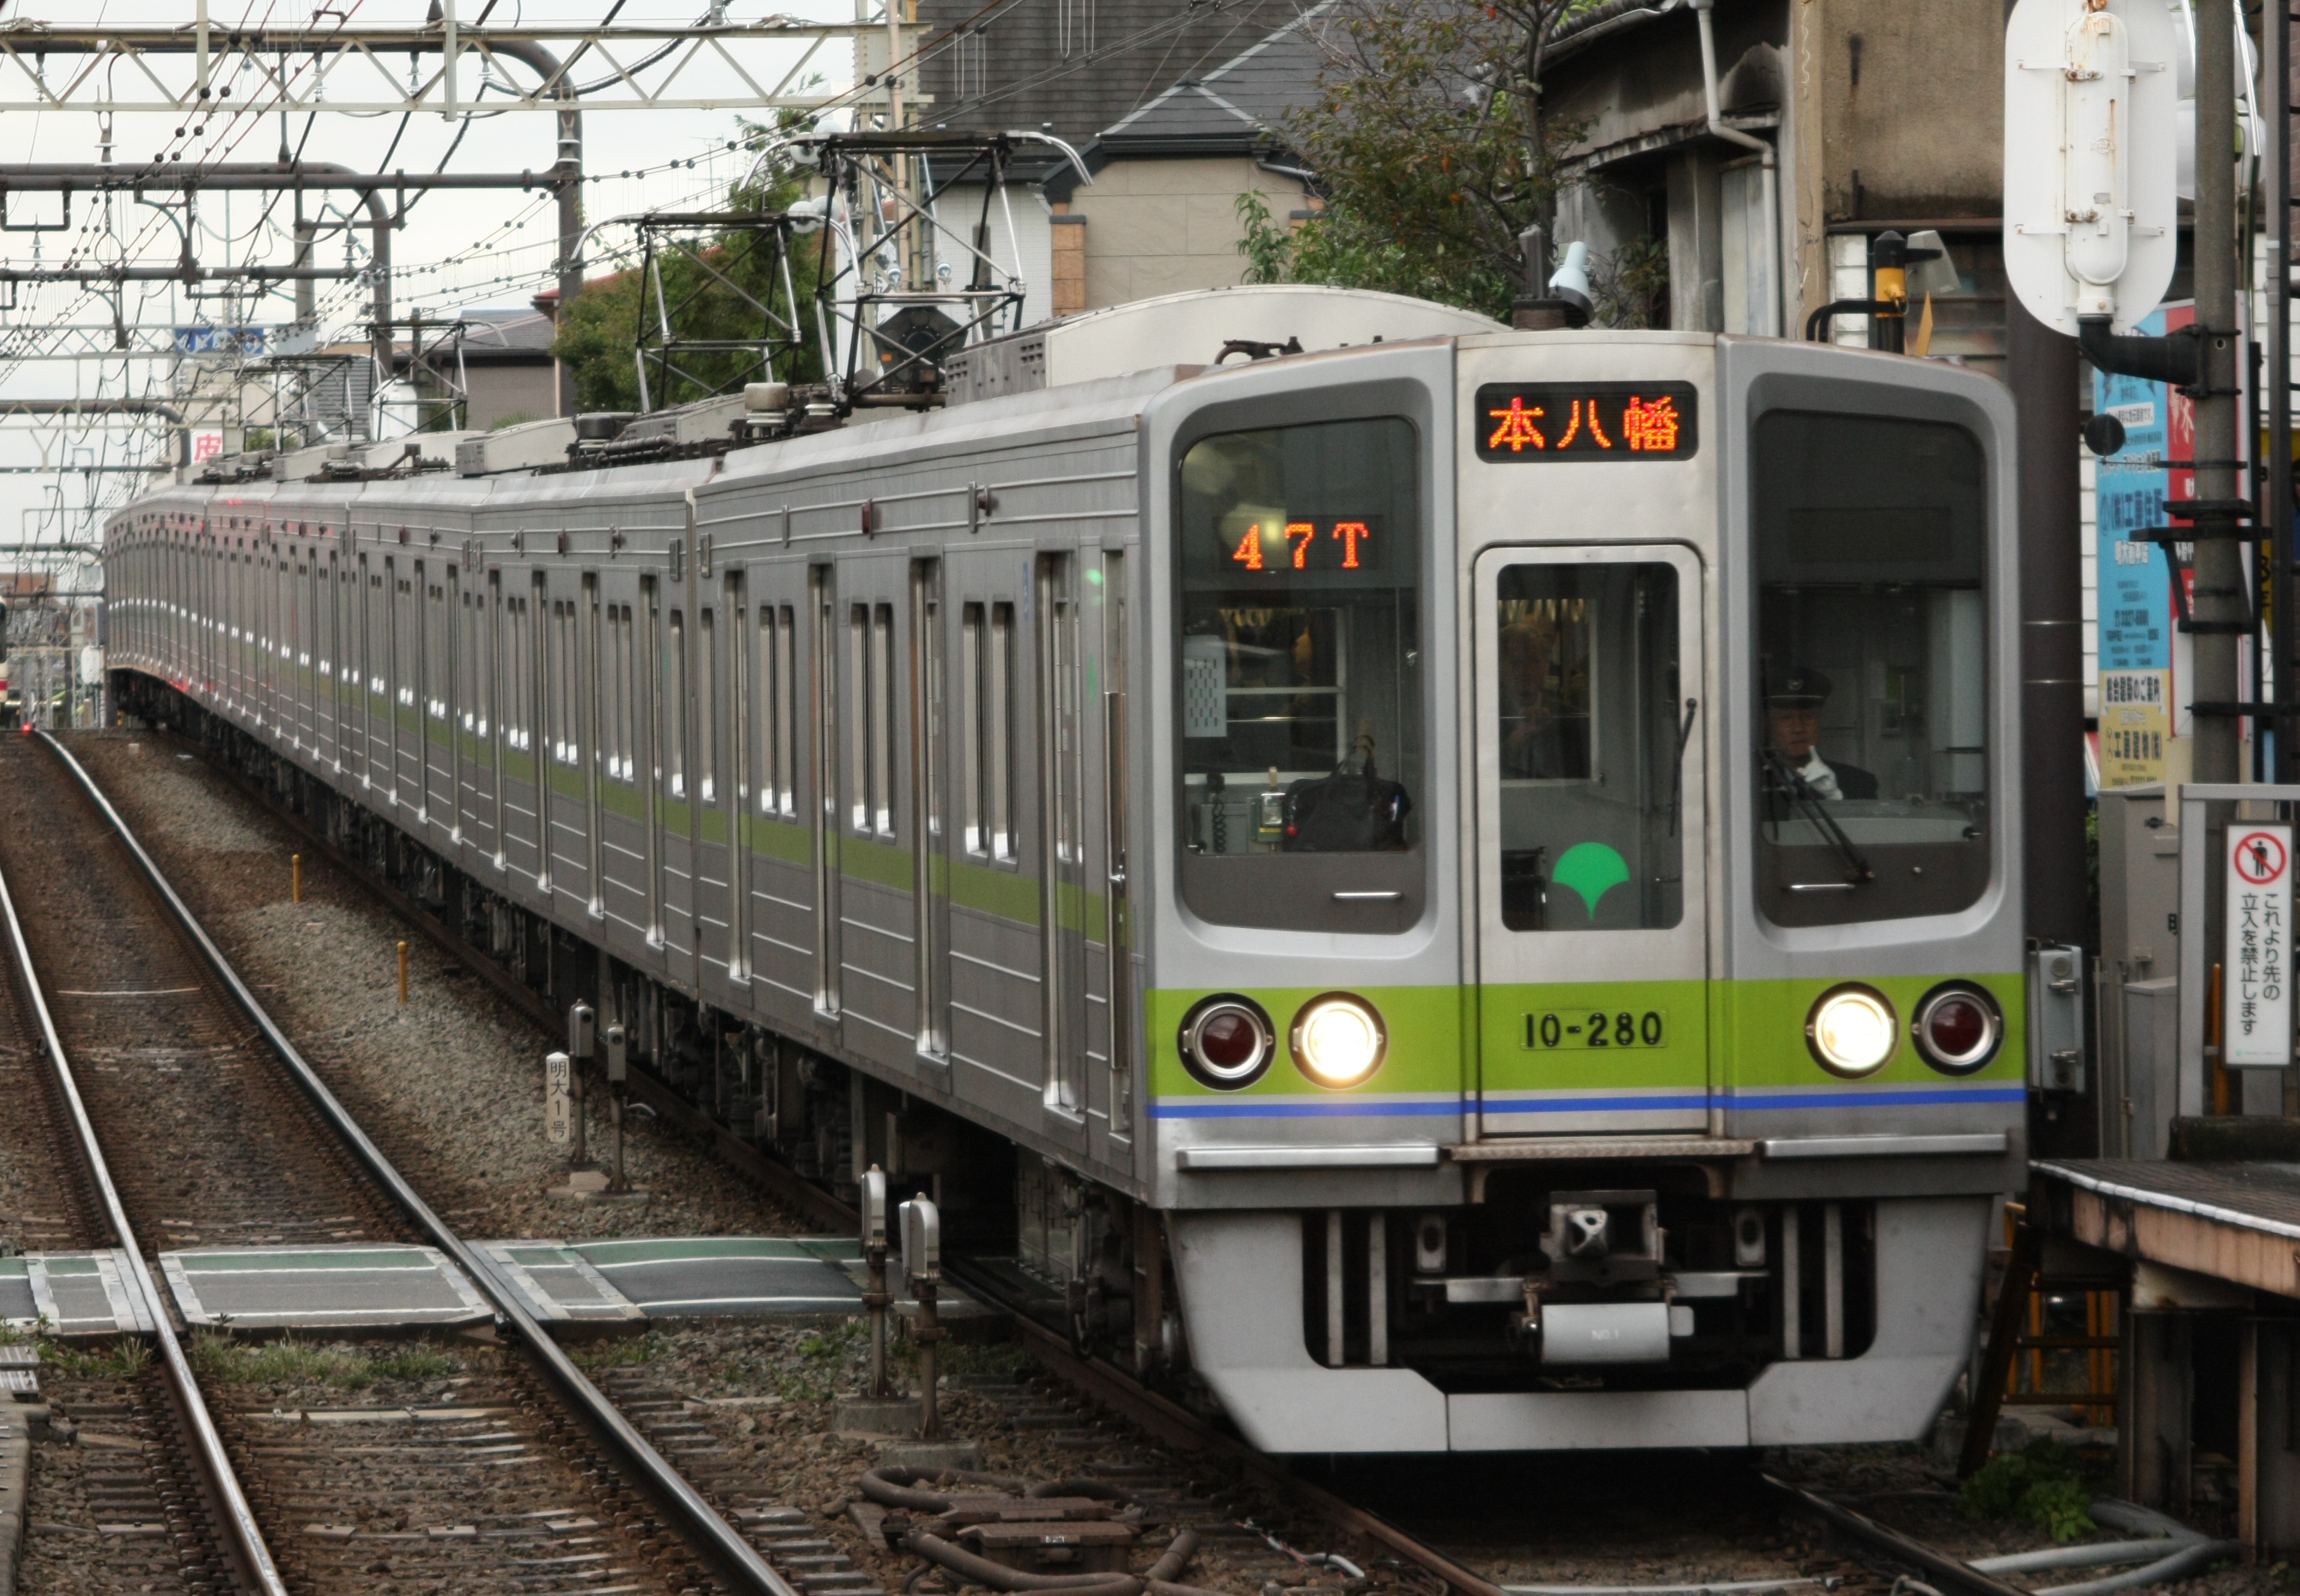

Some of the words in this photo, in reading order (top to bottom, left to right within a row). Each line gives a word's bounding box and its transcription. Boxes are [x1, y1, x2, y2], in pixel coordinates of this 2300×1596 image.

[194, 434, 223, 461] 皮
[1489, 395, 1678, 452] 本八幡
[2241, 893, 2259, 1035] 立入を禁止します
[2263, 893, 2281, 1001] これより先の
[1526, 1010, 1663, 1048] 10-280
[550, 1061, 568, 1138] 明大1号
